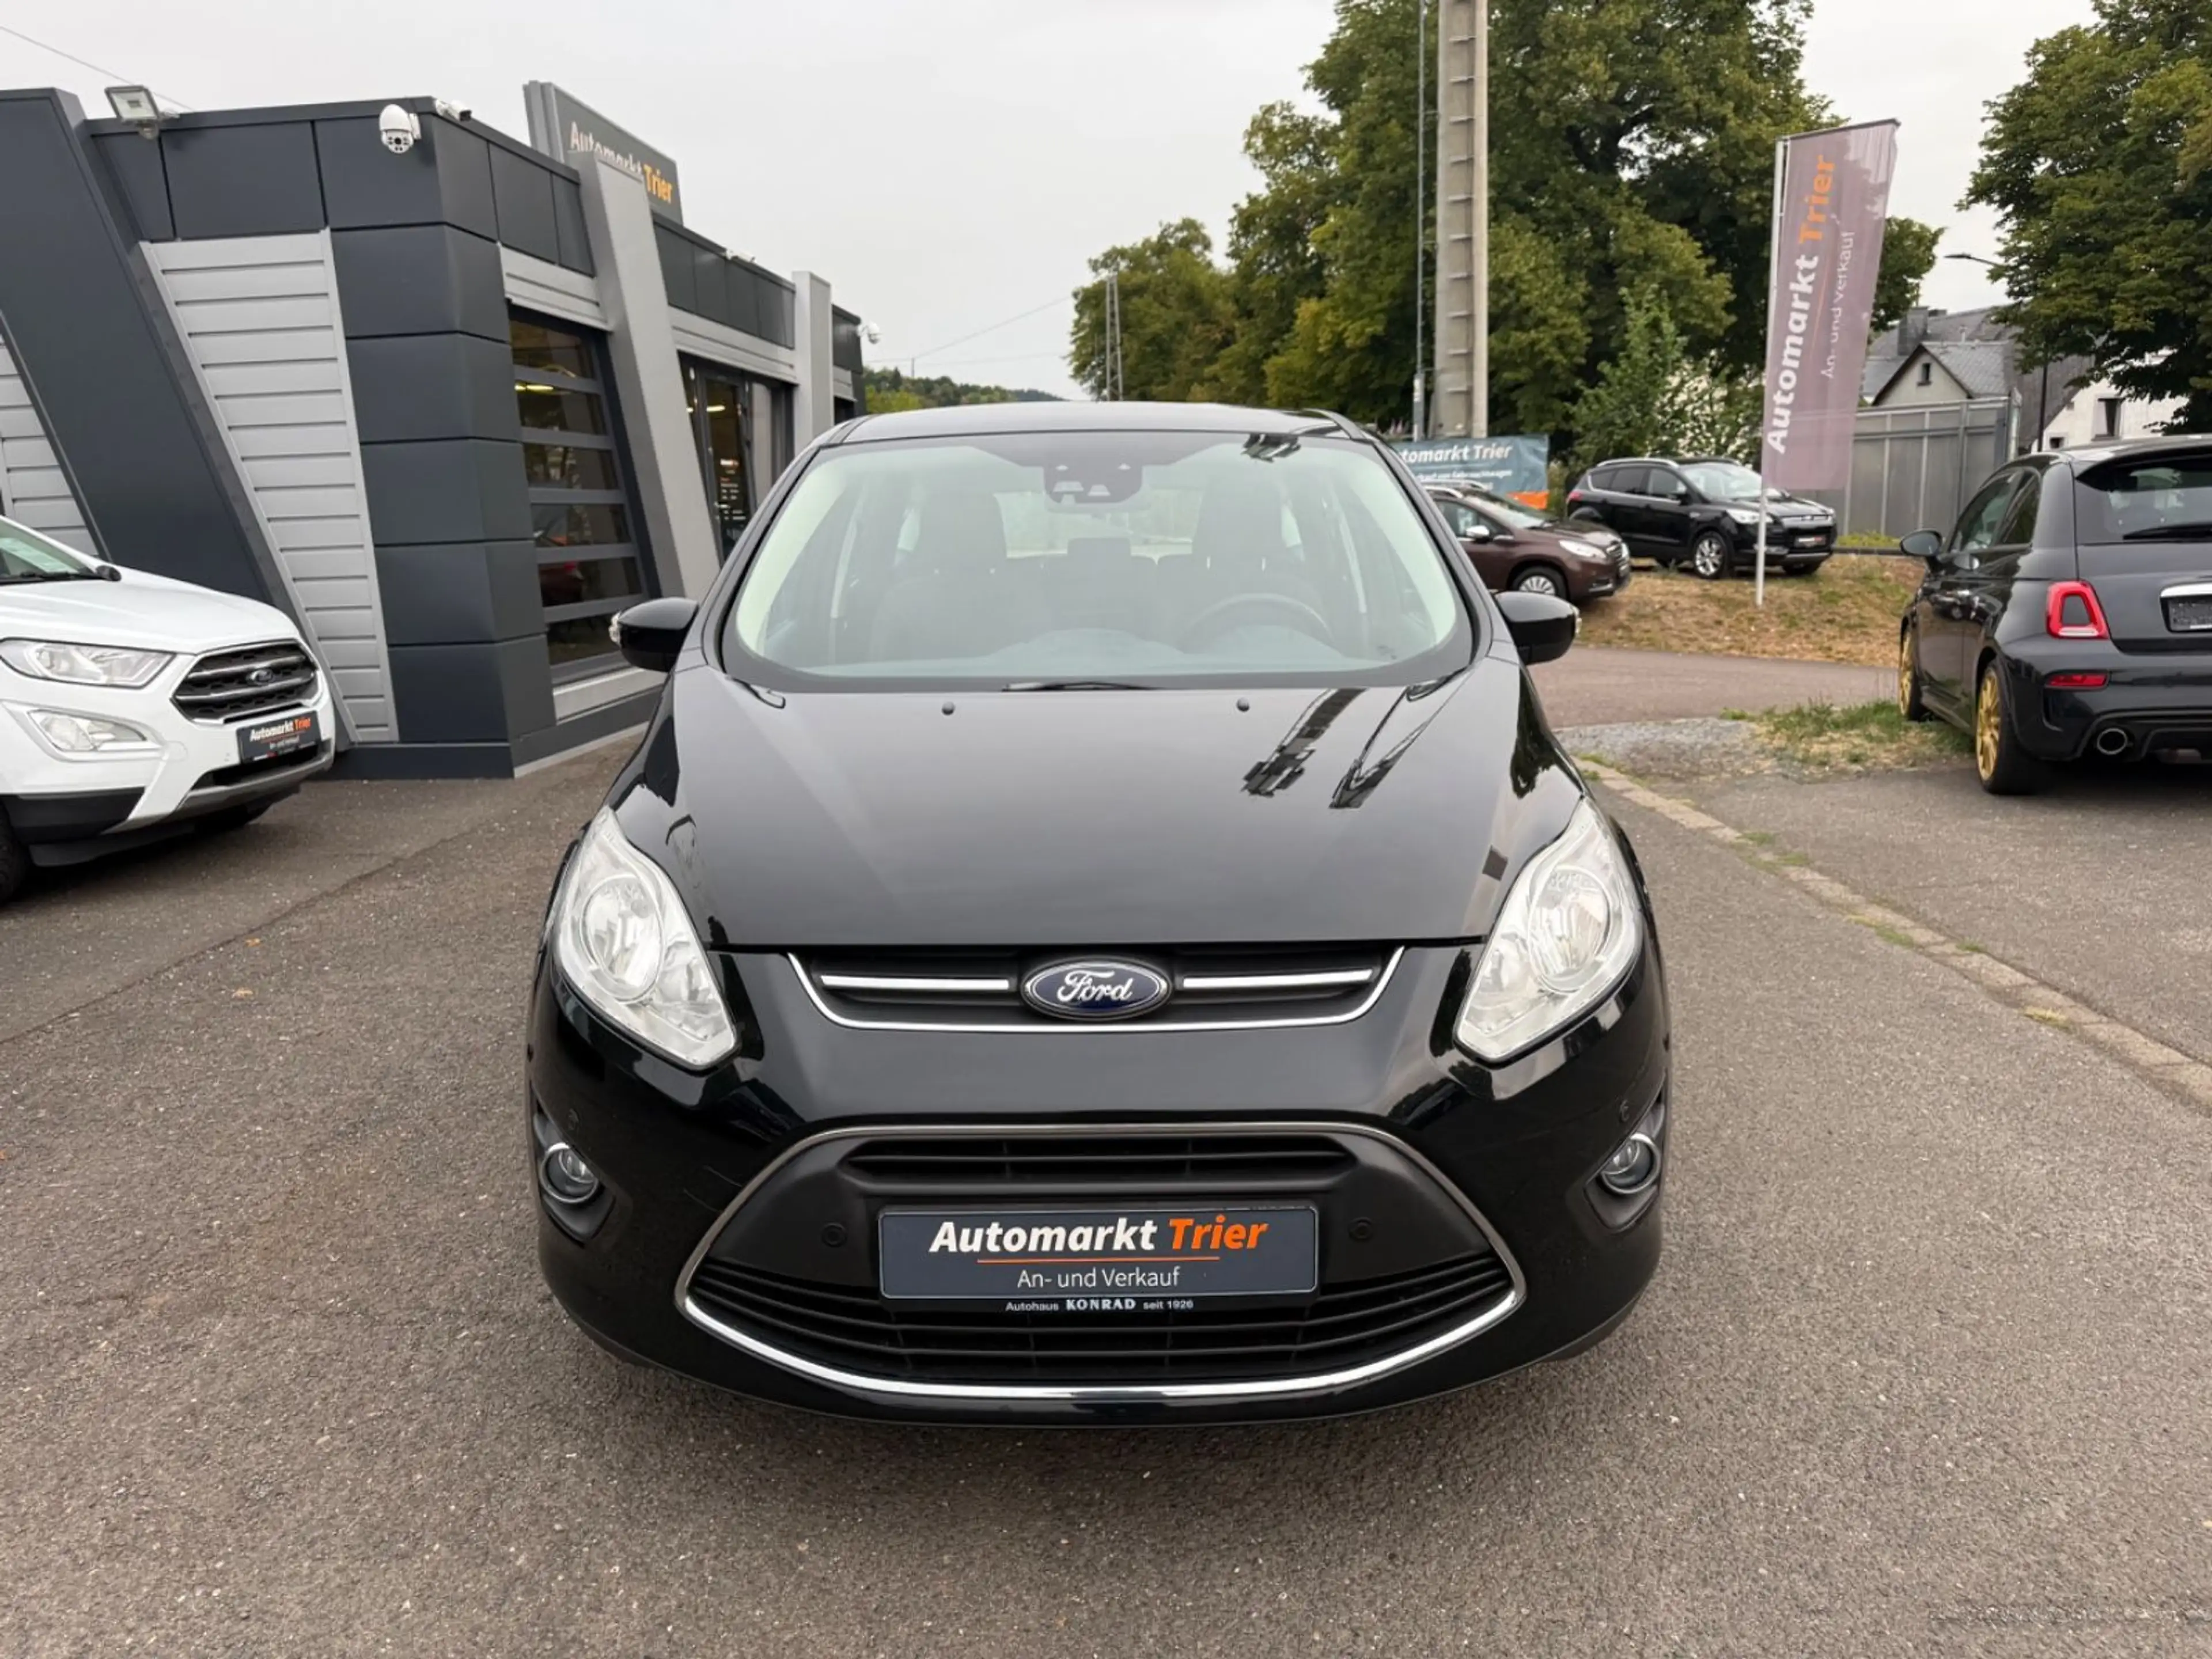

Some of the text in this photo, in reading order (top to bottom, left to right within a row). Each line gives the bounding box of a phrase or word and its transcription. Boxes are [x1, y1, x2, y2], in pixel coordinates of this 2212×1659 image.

[643, 164, 672, 204] Trier
[1767, 154, 1835, 455] Automarkt Trier
[1830, 306, 1843, 343] und
[1471, 442, 1513, 460] Trier
[1056, 970, 1134, 1002] Ford
[929, 1214, 1269, 1253] Automarkt Trier
[1017, 1266, 1181, 1289] An- und Verkauf
[1005, 1301, 1059, 1312] Autohaus
[1066, 1298, 1137, 1310] KONRAD
[1143, 1300, 1164, 1310] seit
